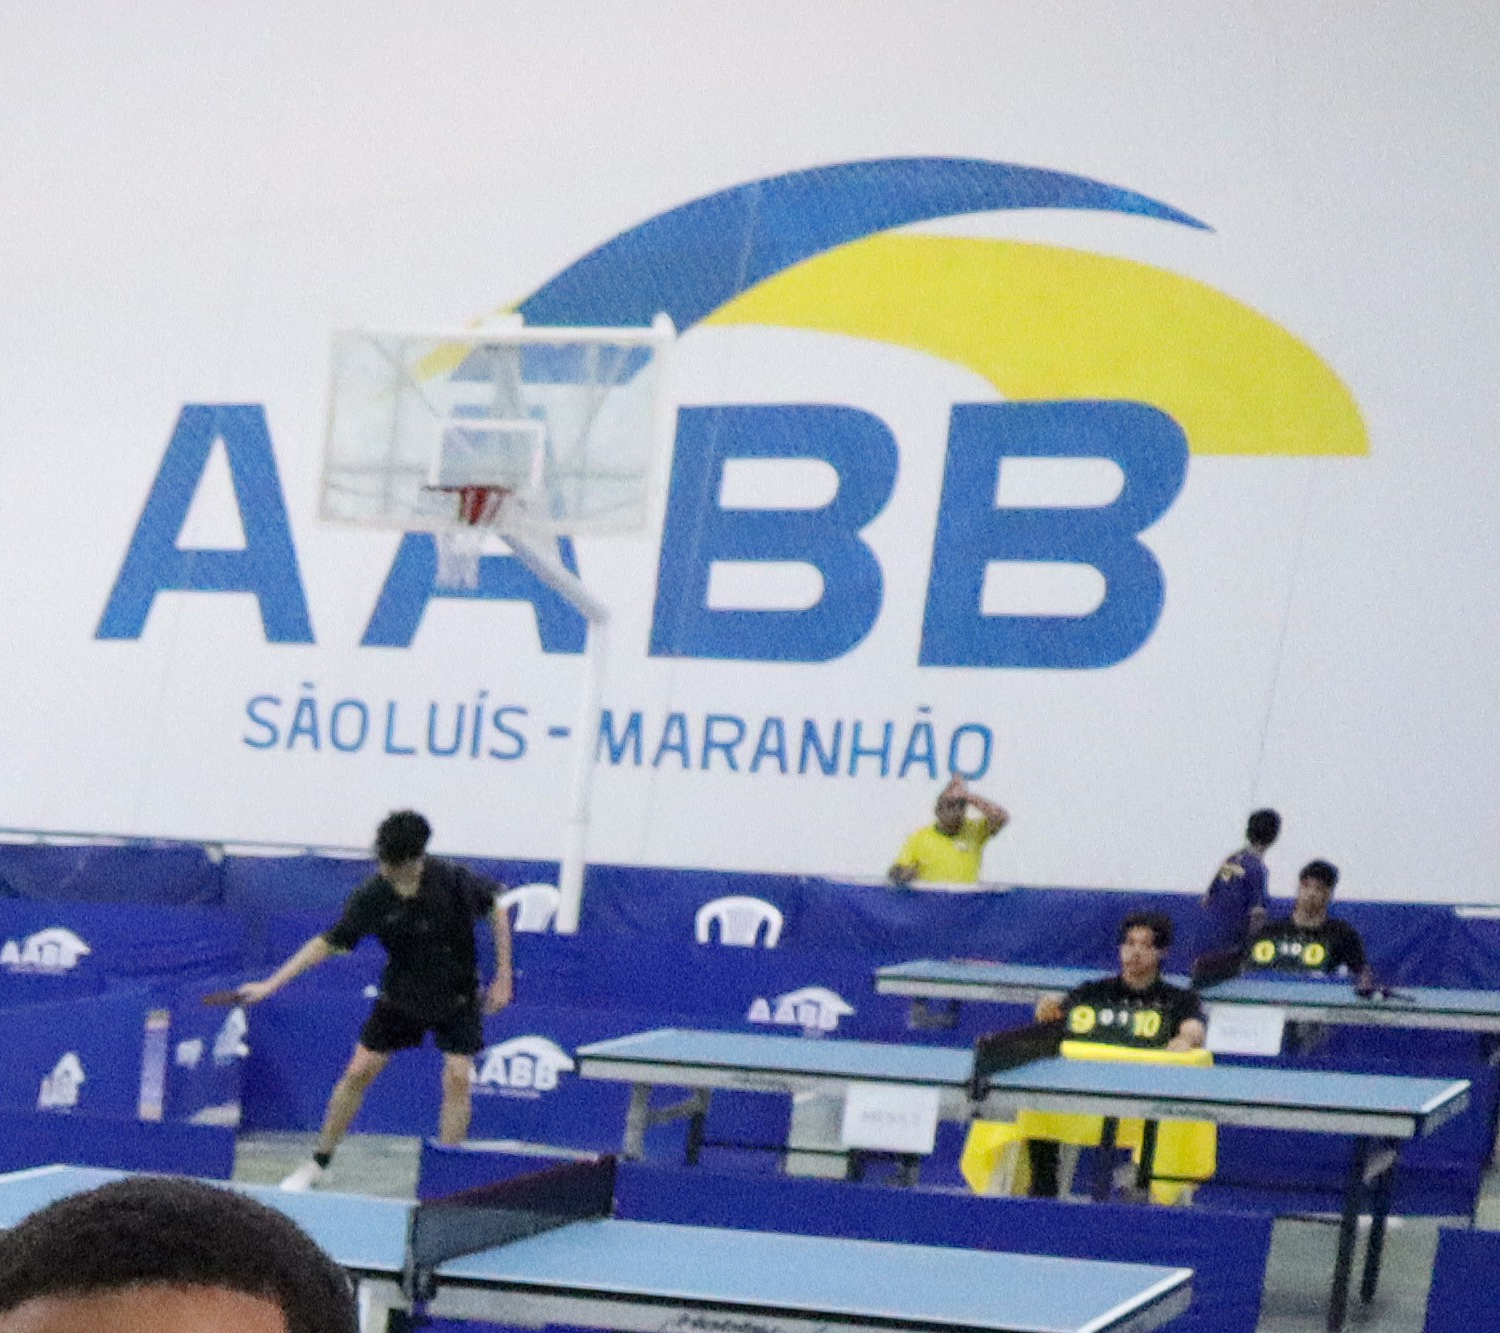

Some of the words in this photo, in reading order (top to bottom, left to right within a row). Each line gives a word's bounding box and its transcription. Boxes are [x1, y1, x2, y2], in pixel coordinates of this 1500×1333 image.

[94, 398, 1190, 671] AABB
[243, 682, 367, 753] SÃO
[386, 688, 531, 763] LUÍS
[596, 698, 994, 784] MARANHÃO
[468, 1053, 559, 1091] ABB
